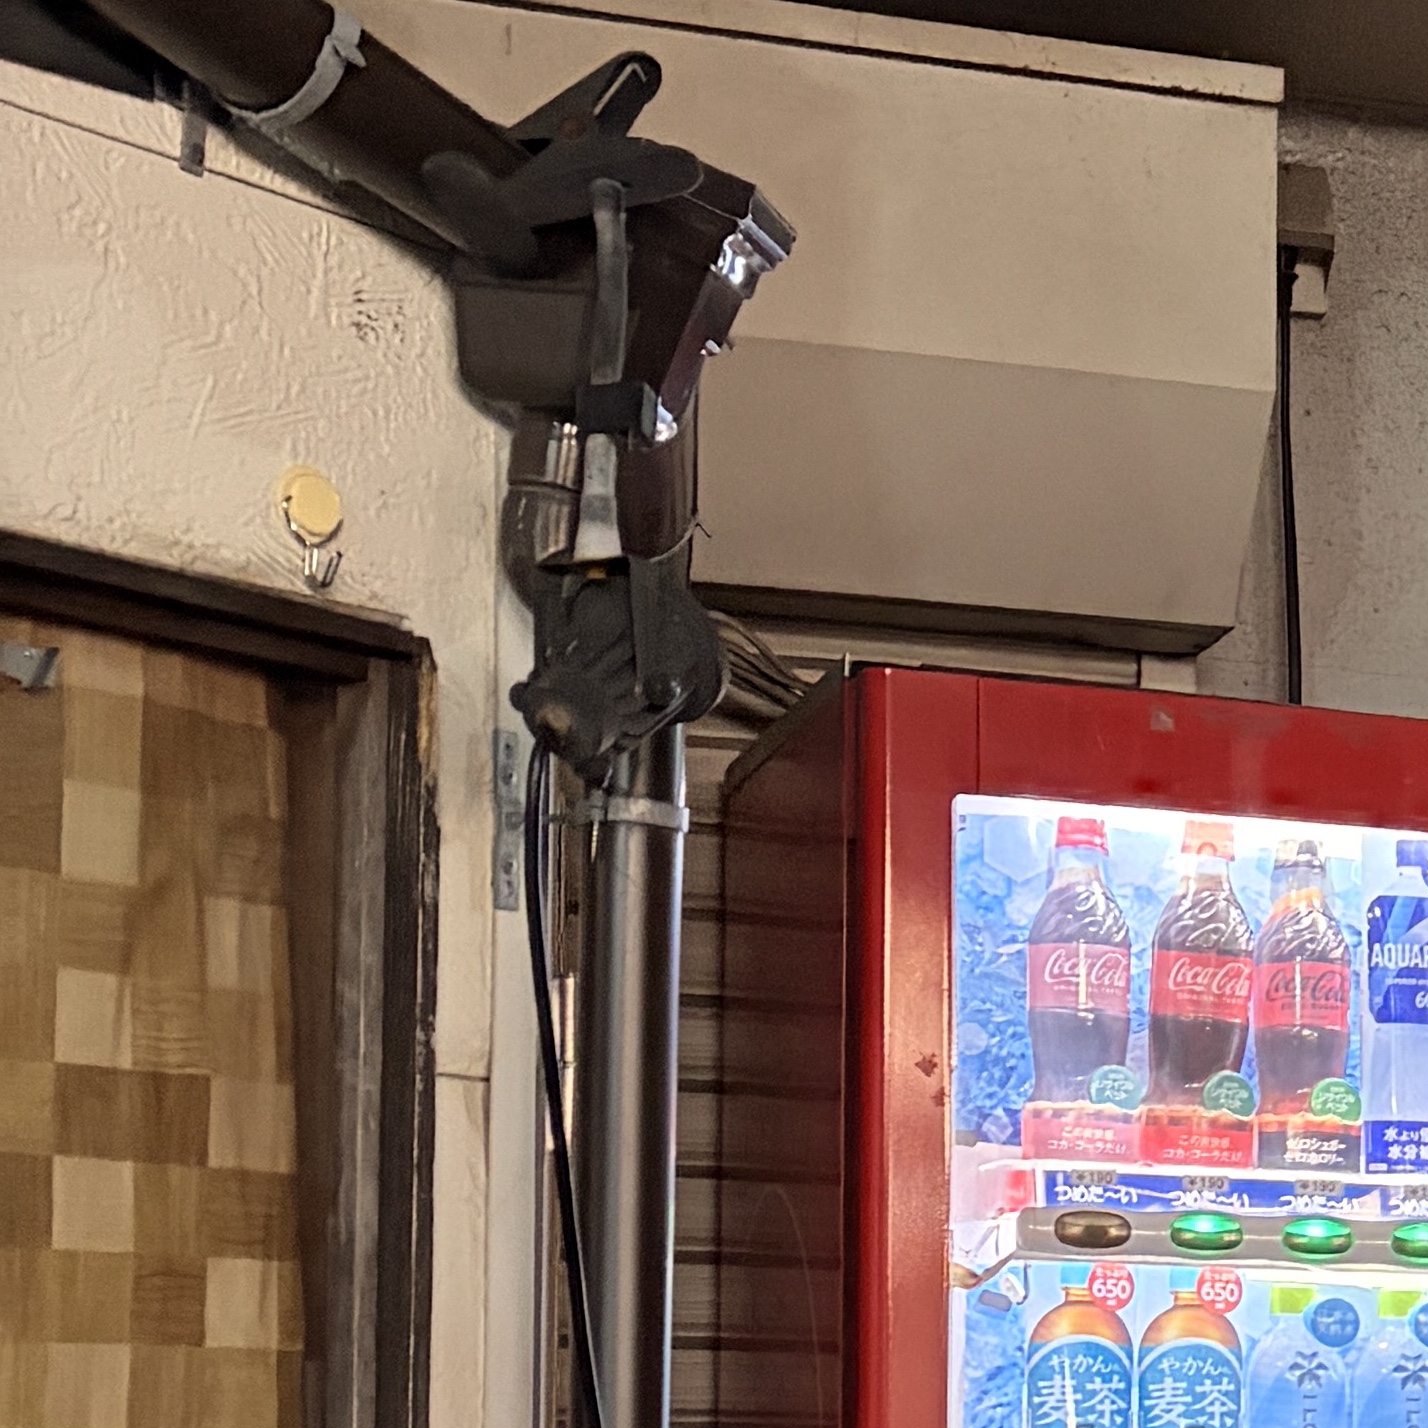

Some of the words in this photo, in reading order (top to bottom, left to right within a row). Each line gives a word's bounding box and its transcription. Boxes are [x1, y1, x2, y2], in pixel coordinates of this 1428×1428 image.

[1091, 1279, 1132, 1300] 650
[1200, 1282, 1239, 1303] 650
[1034, 1374, 1127, 1427] 麦茶
[1144, 1377, 1238, 1428] 麦茶
